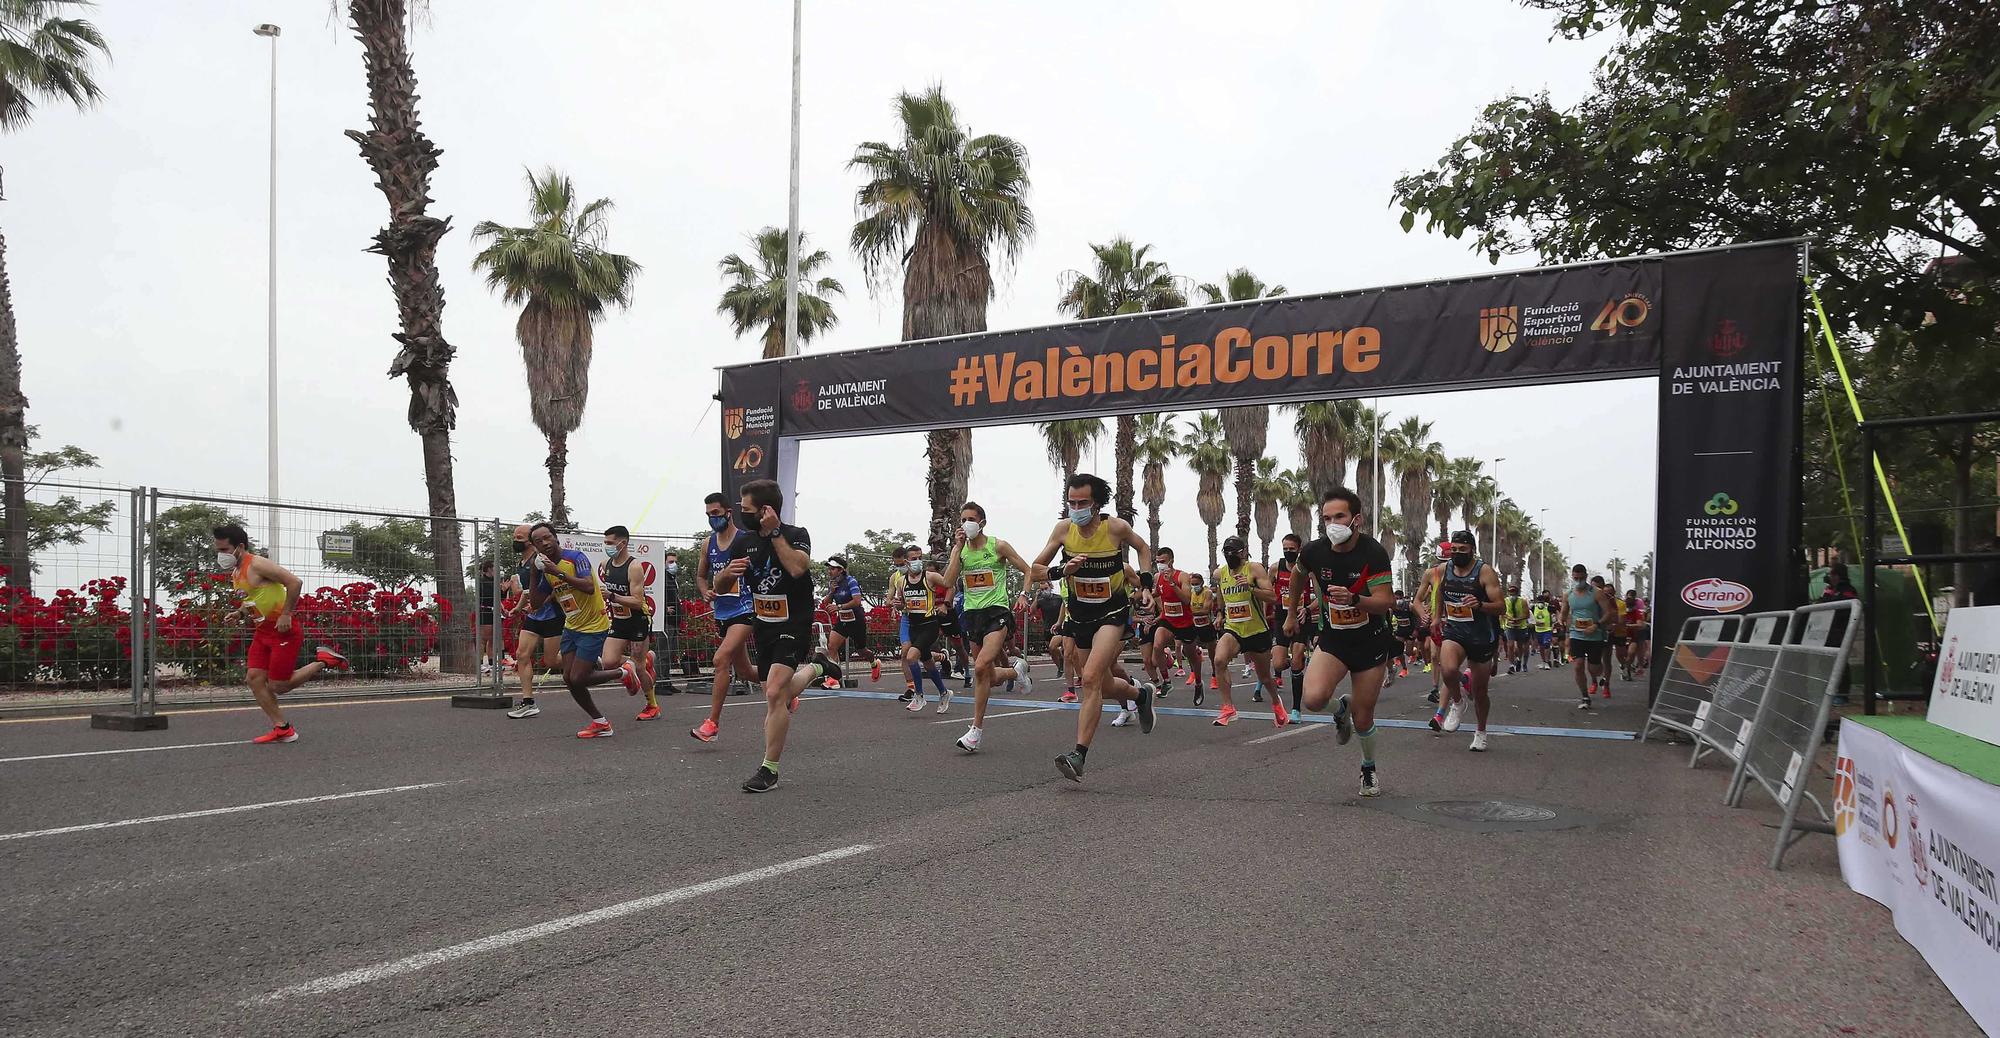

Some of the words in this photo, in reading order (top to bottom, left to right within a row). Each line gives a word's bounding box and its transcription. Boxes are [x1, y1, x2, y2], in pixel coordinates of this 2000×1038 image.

[1523, 302, 1579, 316] Fundació
[1523, 313, 1581, 328] Esportiva
[1590, 298, 1648, 336] 40
[1523, 323, 1583, 337] Municipal
[1524, 335, 1574, 347] València
[949, 326, 1382, 407] #ValènciaCorre
[1673, 361, 1782, 379] AJUNTAMENT
[818, 379, 887, 397] AJUNTAMENT
[1672, 382, 1693, 395] DE
[1699, 377, 1781, 394] VALÈNCIA
[818, 399, 832, 410] DE
[835, 394, 886, 409] VALÈNCIA
[745, 406, 773, 416] Fundació
[745, 413, 774, 424] Esportiva
[745, 421, 774, 430] Municipal
[734, 447, 762, 473] 40
[1686, 516, 1757, 526] FUNDACIÓN
[1685, 527, 1757, 539] TRINIDAD
[1685, 539, 1757, 550] ALFONSO
[972, 573, 985, 583] 73
[1082, 583, 1104, 593] 115
[1689, 588, 1745, 602] Serrano
[758, 600, 781, 611] 340
[1229, 606, 1246, 614] 204
[1334, 609, 1361, 619] 138
[1929, 828, 1999, 906] AJUNTAMENT
[1931, 868, 1947, 907] DE
